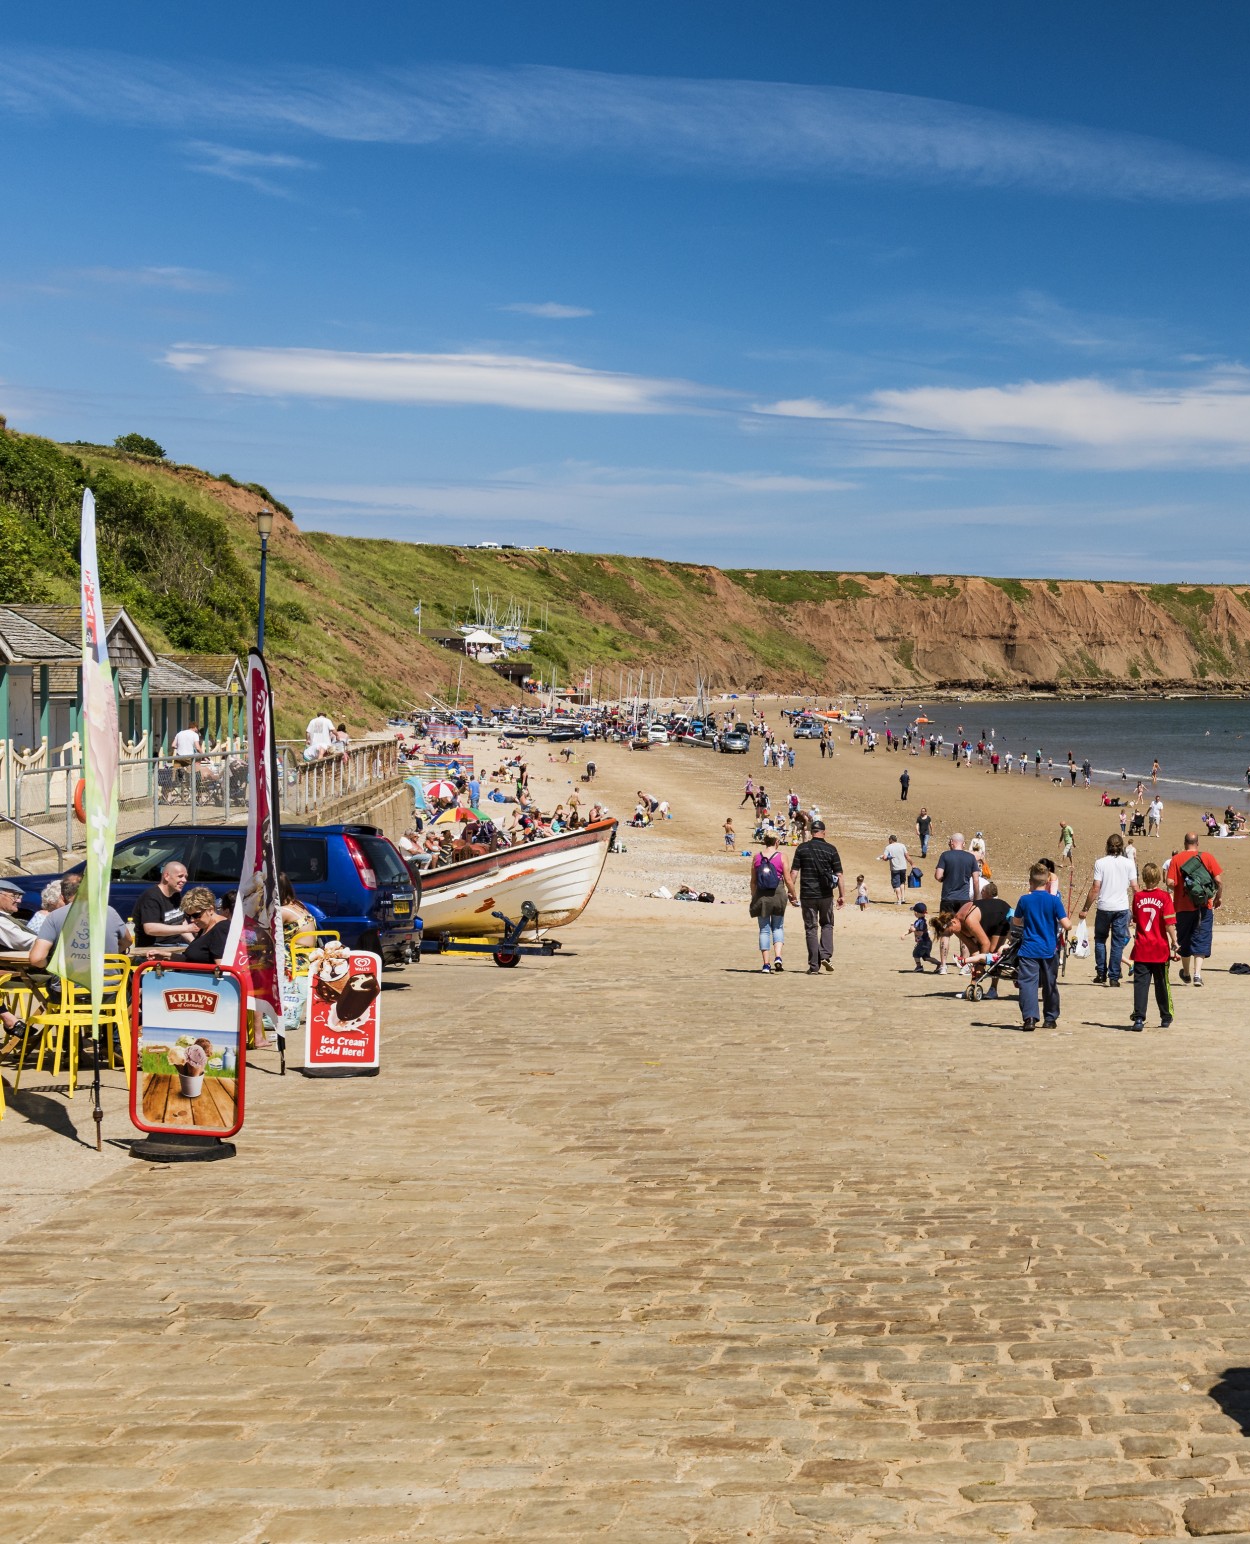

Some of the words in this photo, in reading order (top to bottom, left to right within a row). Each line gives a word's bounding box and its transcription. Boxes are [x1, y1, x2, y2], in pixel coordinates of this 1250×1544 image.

[1142, 907, 1156, 932] 7
[168, 993, 214, 1006] KELLY'S
[320, 1035, 335, 1044] Ice
[337, 1036, 366, 1047] Cream
[319, 1045, 341, 1055] Sold
[341, 1047, 365, 1057] Here!
